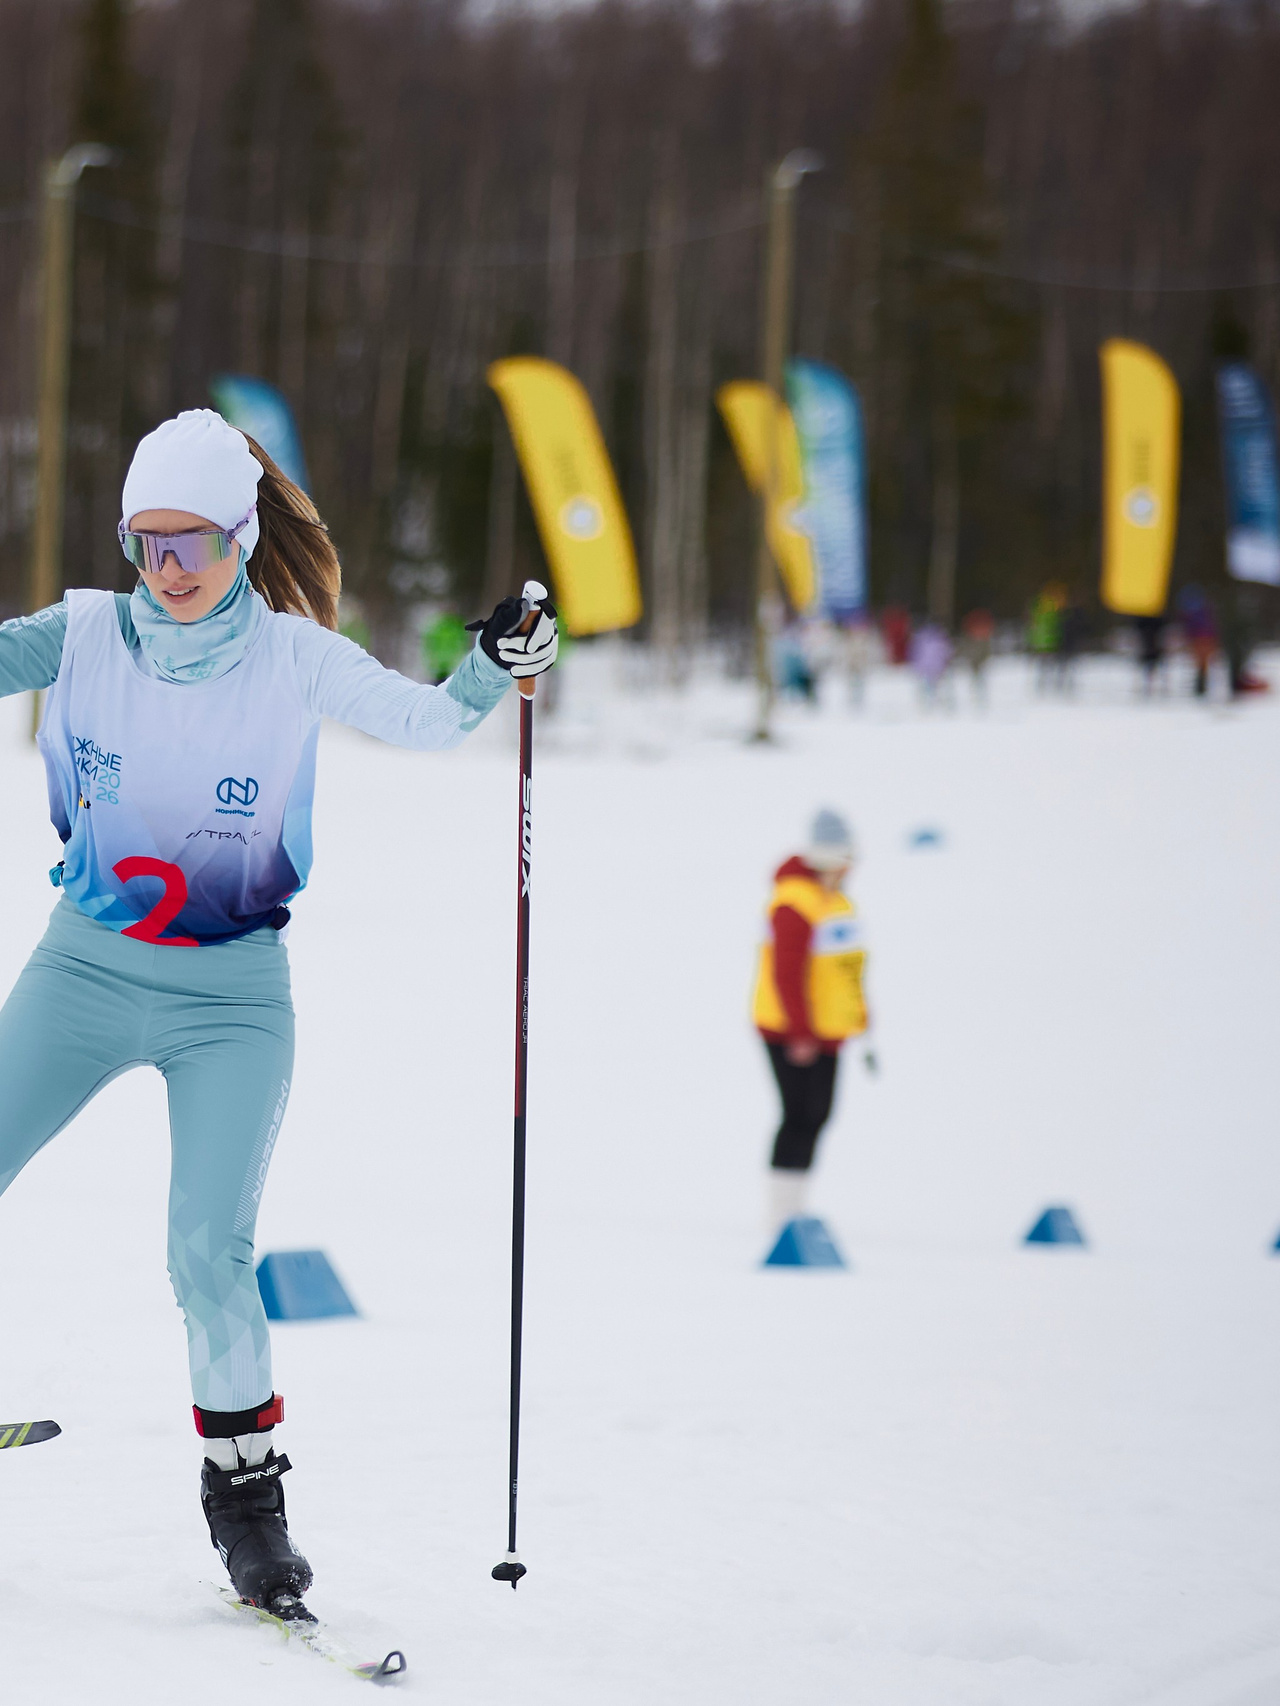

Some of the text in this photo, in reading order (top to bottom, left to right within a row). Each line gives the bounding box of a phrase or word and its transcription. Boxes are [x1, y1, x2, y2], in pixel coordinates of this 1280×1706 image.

[73, 736, 122, 772] ЖНЫЕ
[98, 768, 121, 789] 20
[96, 786, 119, 805] 26
[112, 856, 200, 947] 2
[252, 1079, 289, 1202] NORDSKI
[231, 1464, 280, 1486] SPINE
